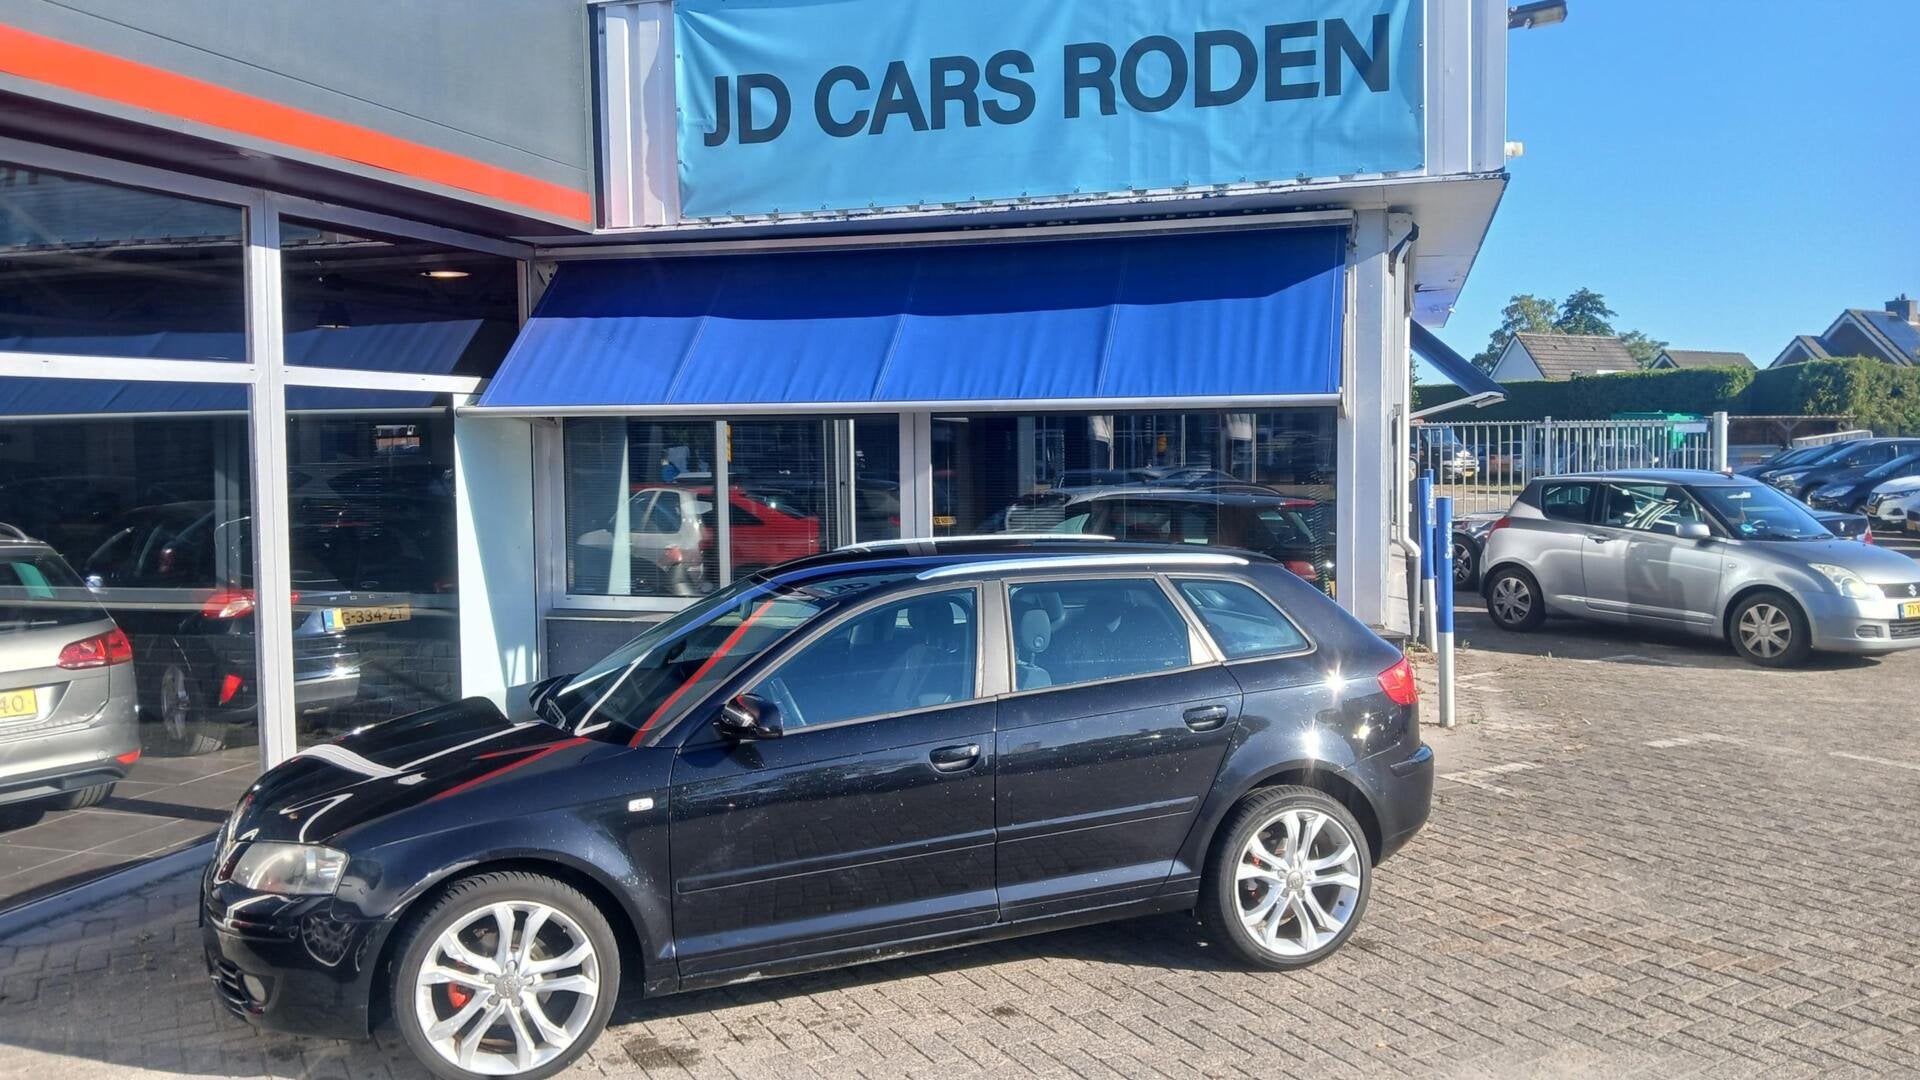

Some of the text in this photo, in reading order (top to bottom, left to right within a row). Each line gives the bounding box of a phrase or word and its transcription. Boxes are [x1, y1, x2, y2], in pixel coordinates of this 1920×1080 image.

[704, 13, 1390, 147] JD CARS RODEN
[1445, 521, 1453, 559] Service
